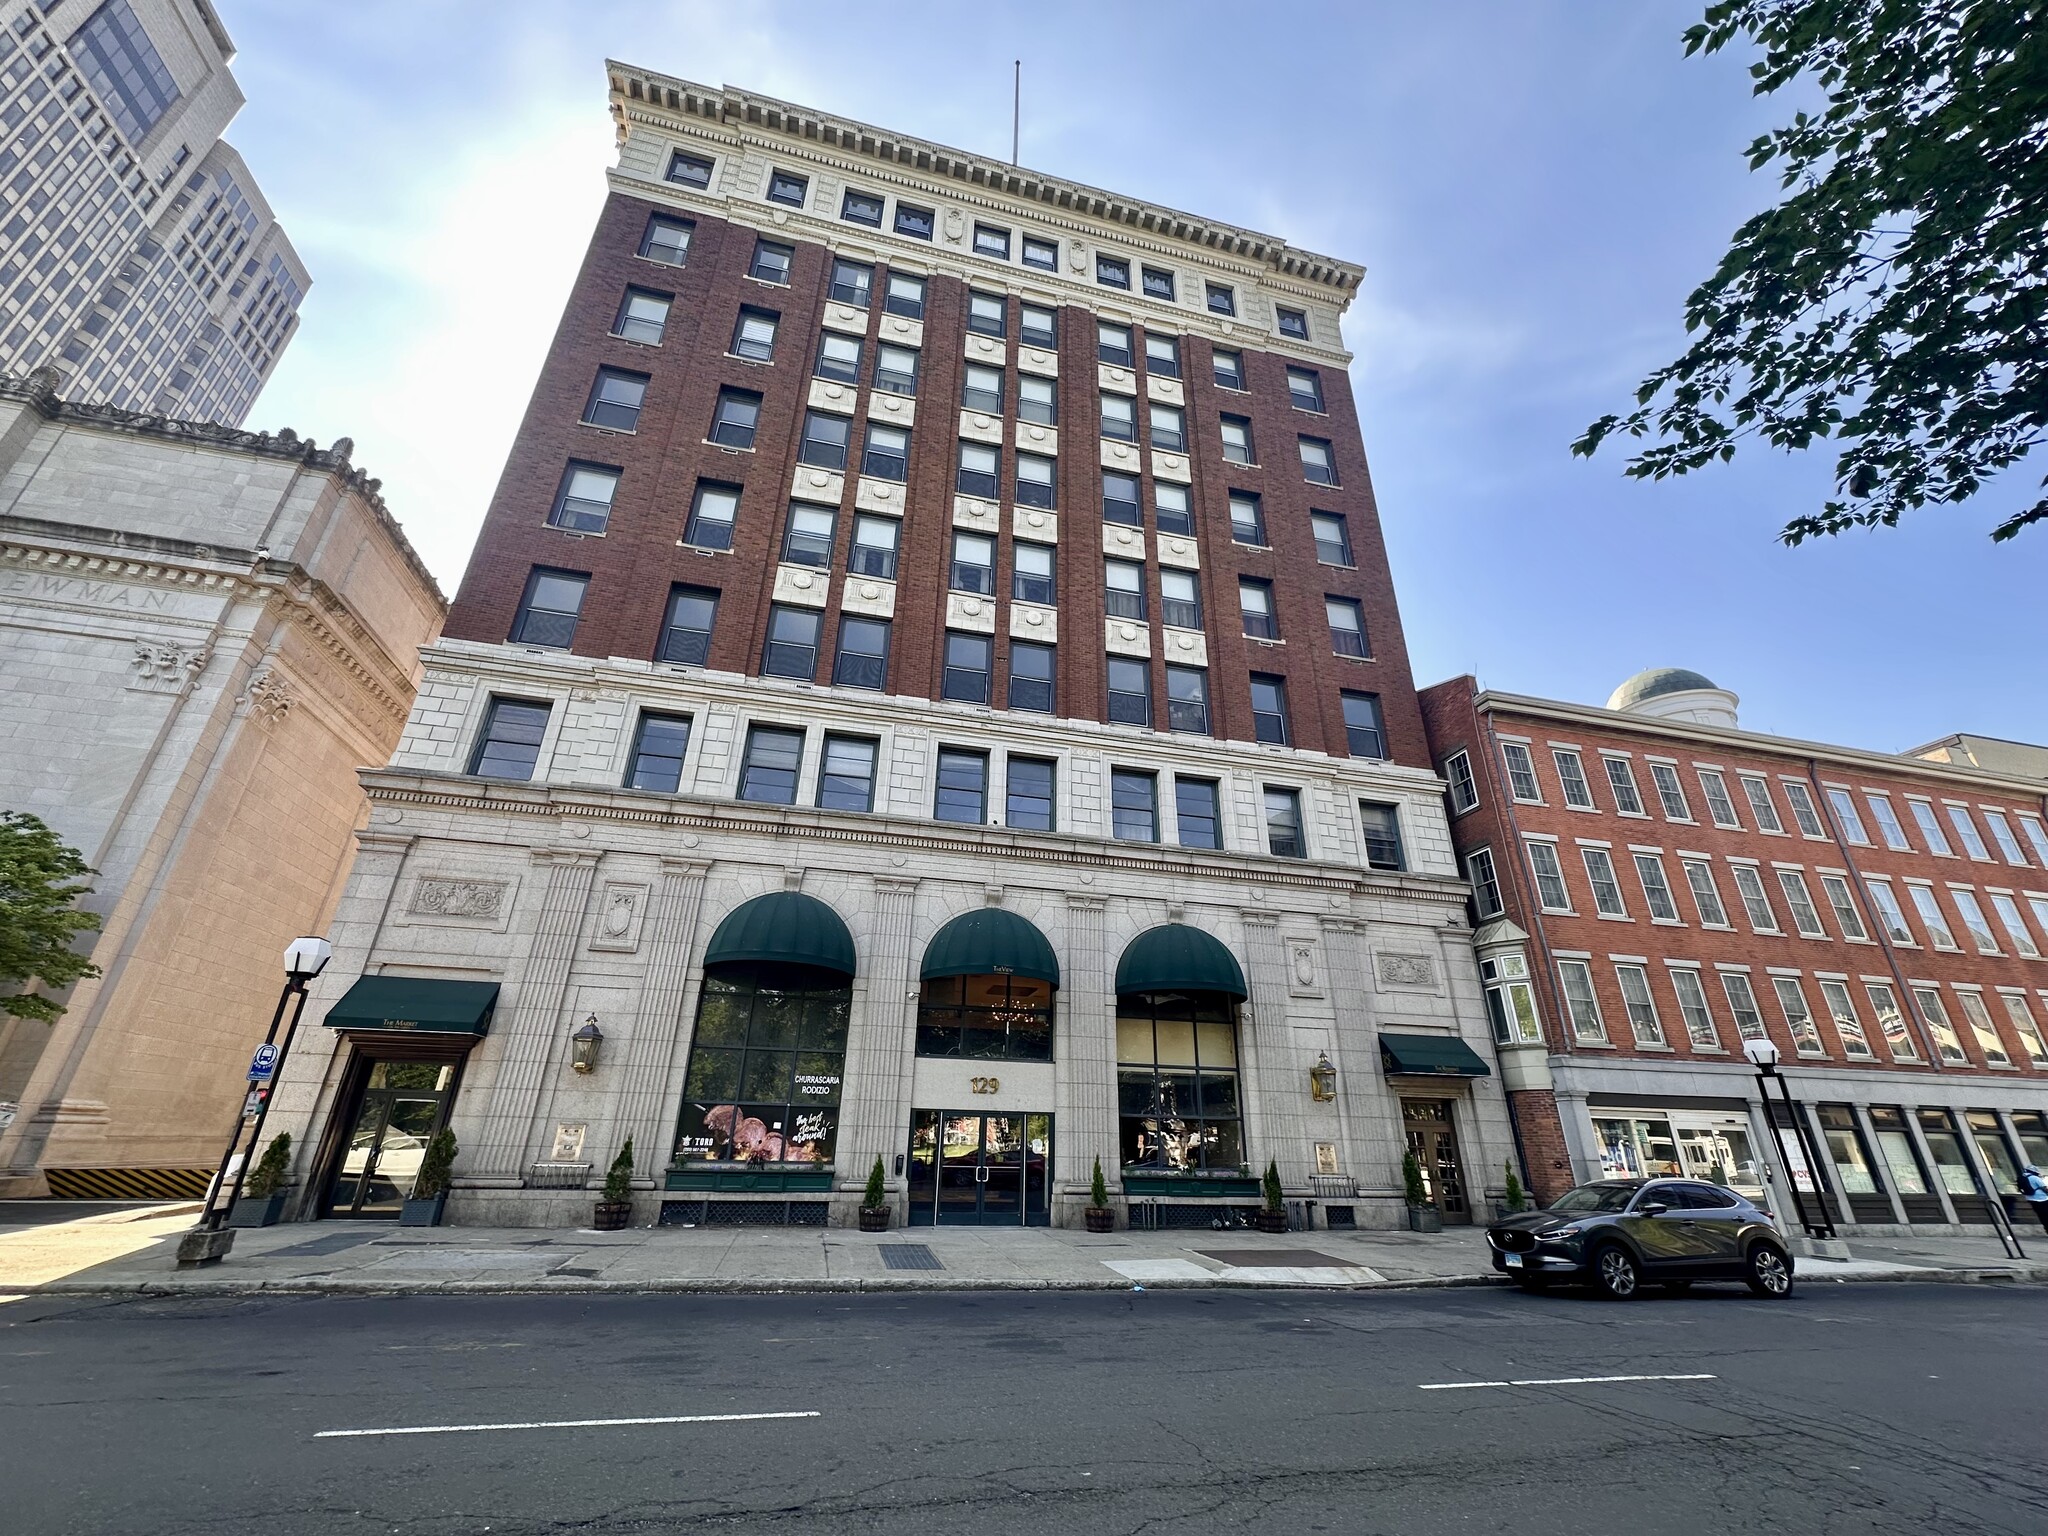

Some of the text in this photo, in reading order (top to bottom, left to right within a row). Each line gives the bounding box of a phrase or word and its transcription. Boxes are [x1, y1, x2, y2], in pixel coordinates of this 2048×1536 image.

[795, 1075, 840, 1085] CHURRASCARIA
[970, 1076, 1000, 1095] 129
[802, 1086, 830, 1095] RODIZIO
[694, 1137, 714, 1146] TORO
